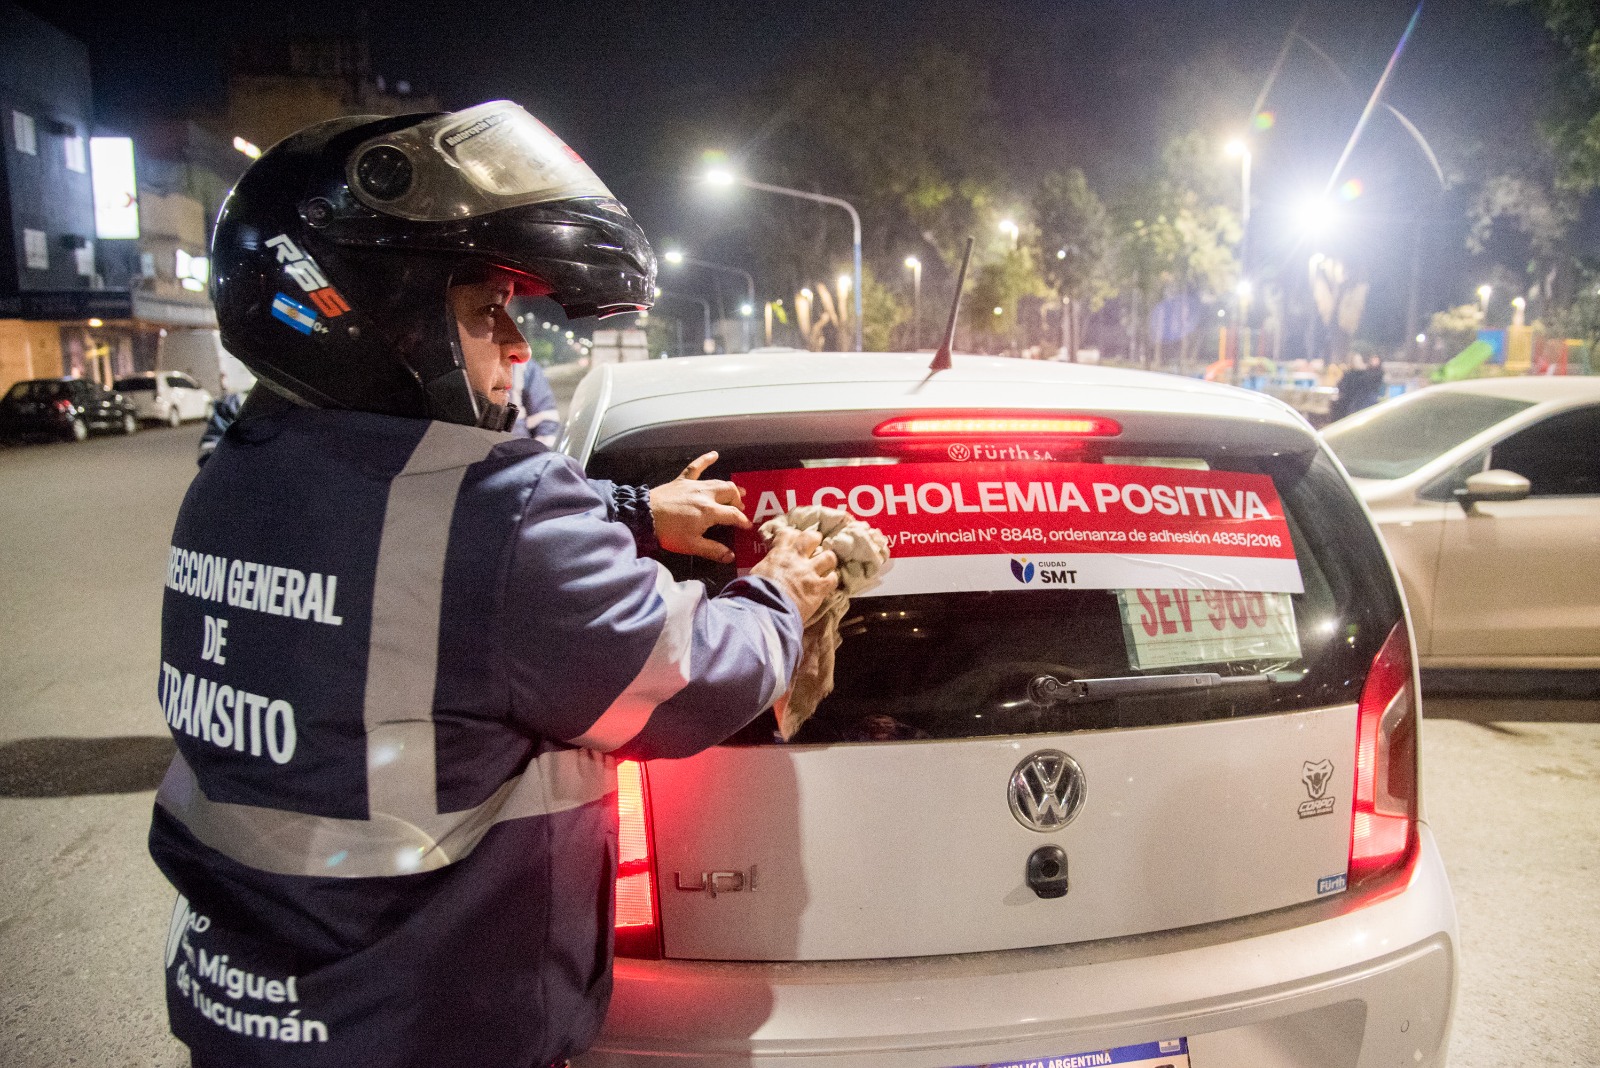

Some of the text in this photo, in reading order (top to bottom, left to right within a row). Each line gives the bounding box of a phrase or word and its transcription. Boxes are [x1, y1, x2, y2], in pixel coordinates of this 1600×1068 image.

[973, 444, 1029, 460] Fürth
[1033, 450, 1057, 461] S.A.
[1092, 482, 1273, 520] POSITIVA
[900, 529, 976, 545] Provincial
[1001, 527, 1047, 544] 8848,
[1049, 528, 1127, 543] ordenanza
[1129, 529, 1147, 542] de
[1149, 529, 1211, 545] adhesión
[1212, 531, 1282, 548] 4835/2016
[227, 559, 344, 626] GENERAL
[1040, 570, 1077, 584] SMT
[201, 615, 229, 666] DE
[163, 661, 298, 765] TRANSITO
[1319, 875, 1345, 893] Fürth
[199, 948, 298, 1003] Miguel
[191, 979, 329, 1042] Tucumán
[1048, 1052, 1112, 1068] ARGENTINA
